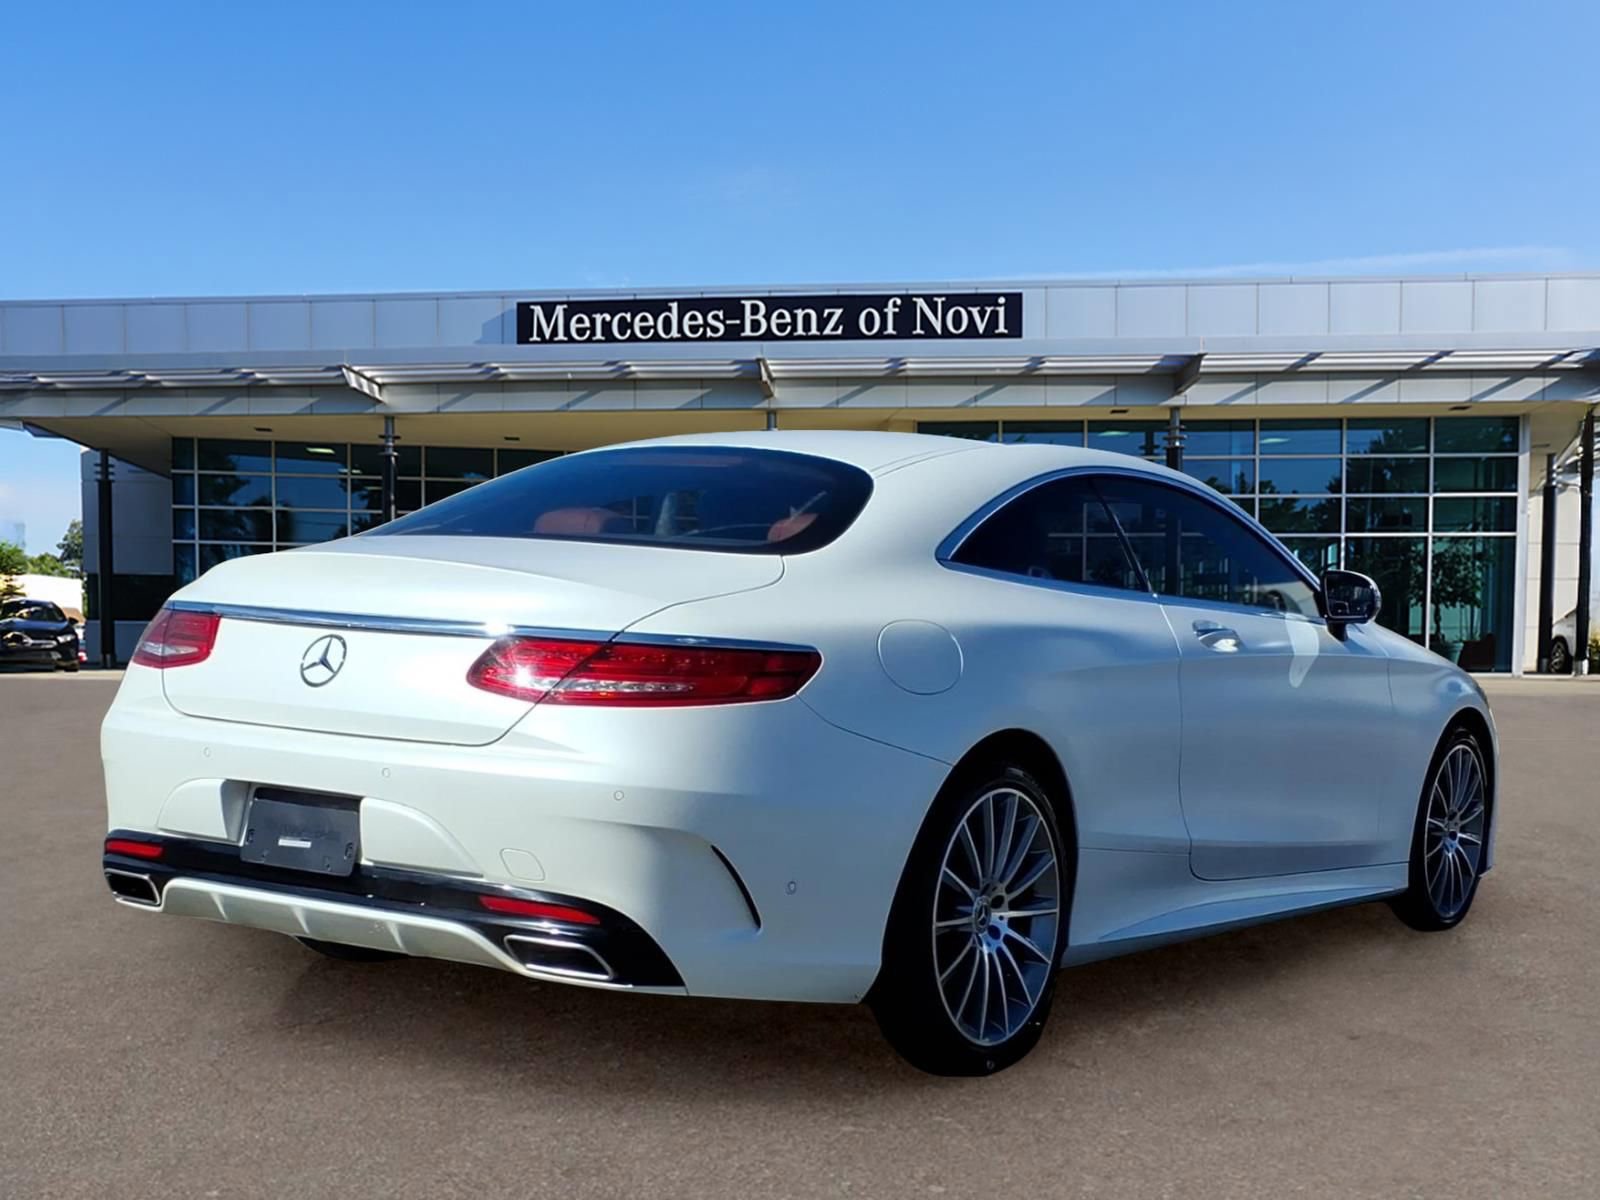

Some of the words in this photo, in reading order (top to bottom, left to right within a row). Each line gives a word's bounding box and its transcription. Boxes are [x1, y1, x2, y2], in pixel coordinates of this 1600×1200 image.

[529, 299, 844, 342] Mercedes-Benz
[858, 297, 902, 336] of
[911, 295, 1009, 335] Novi
